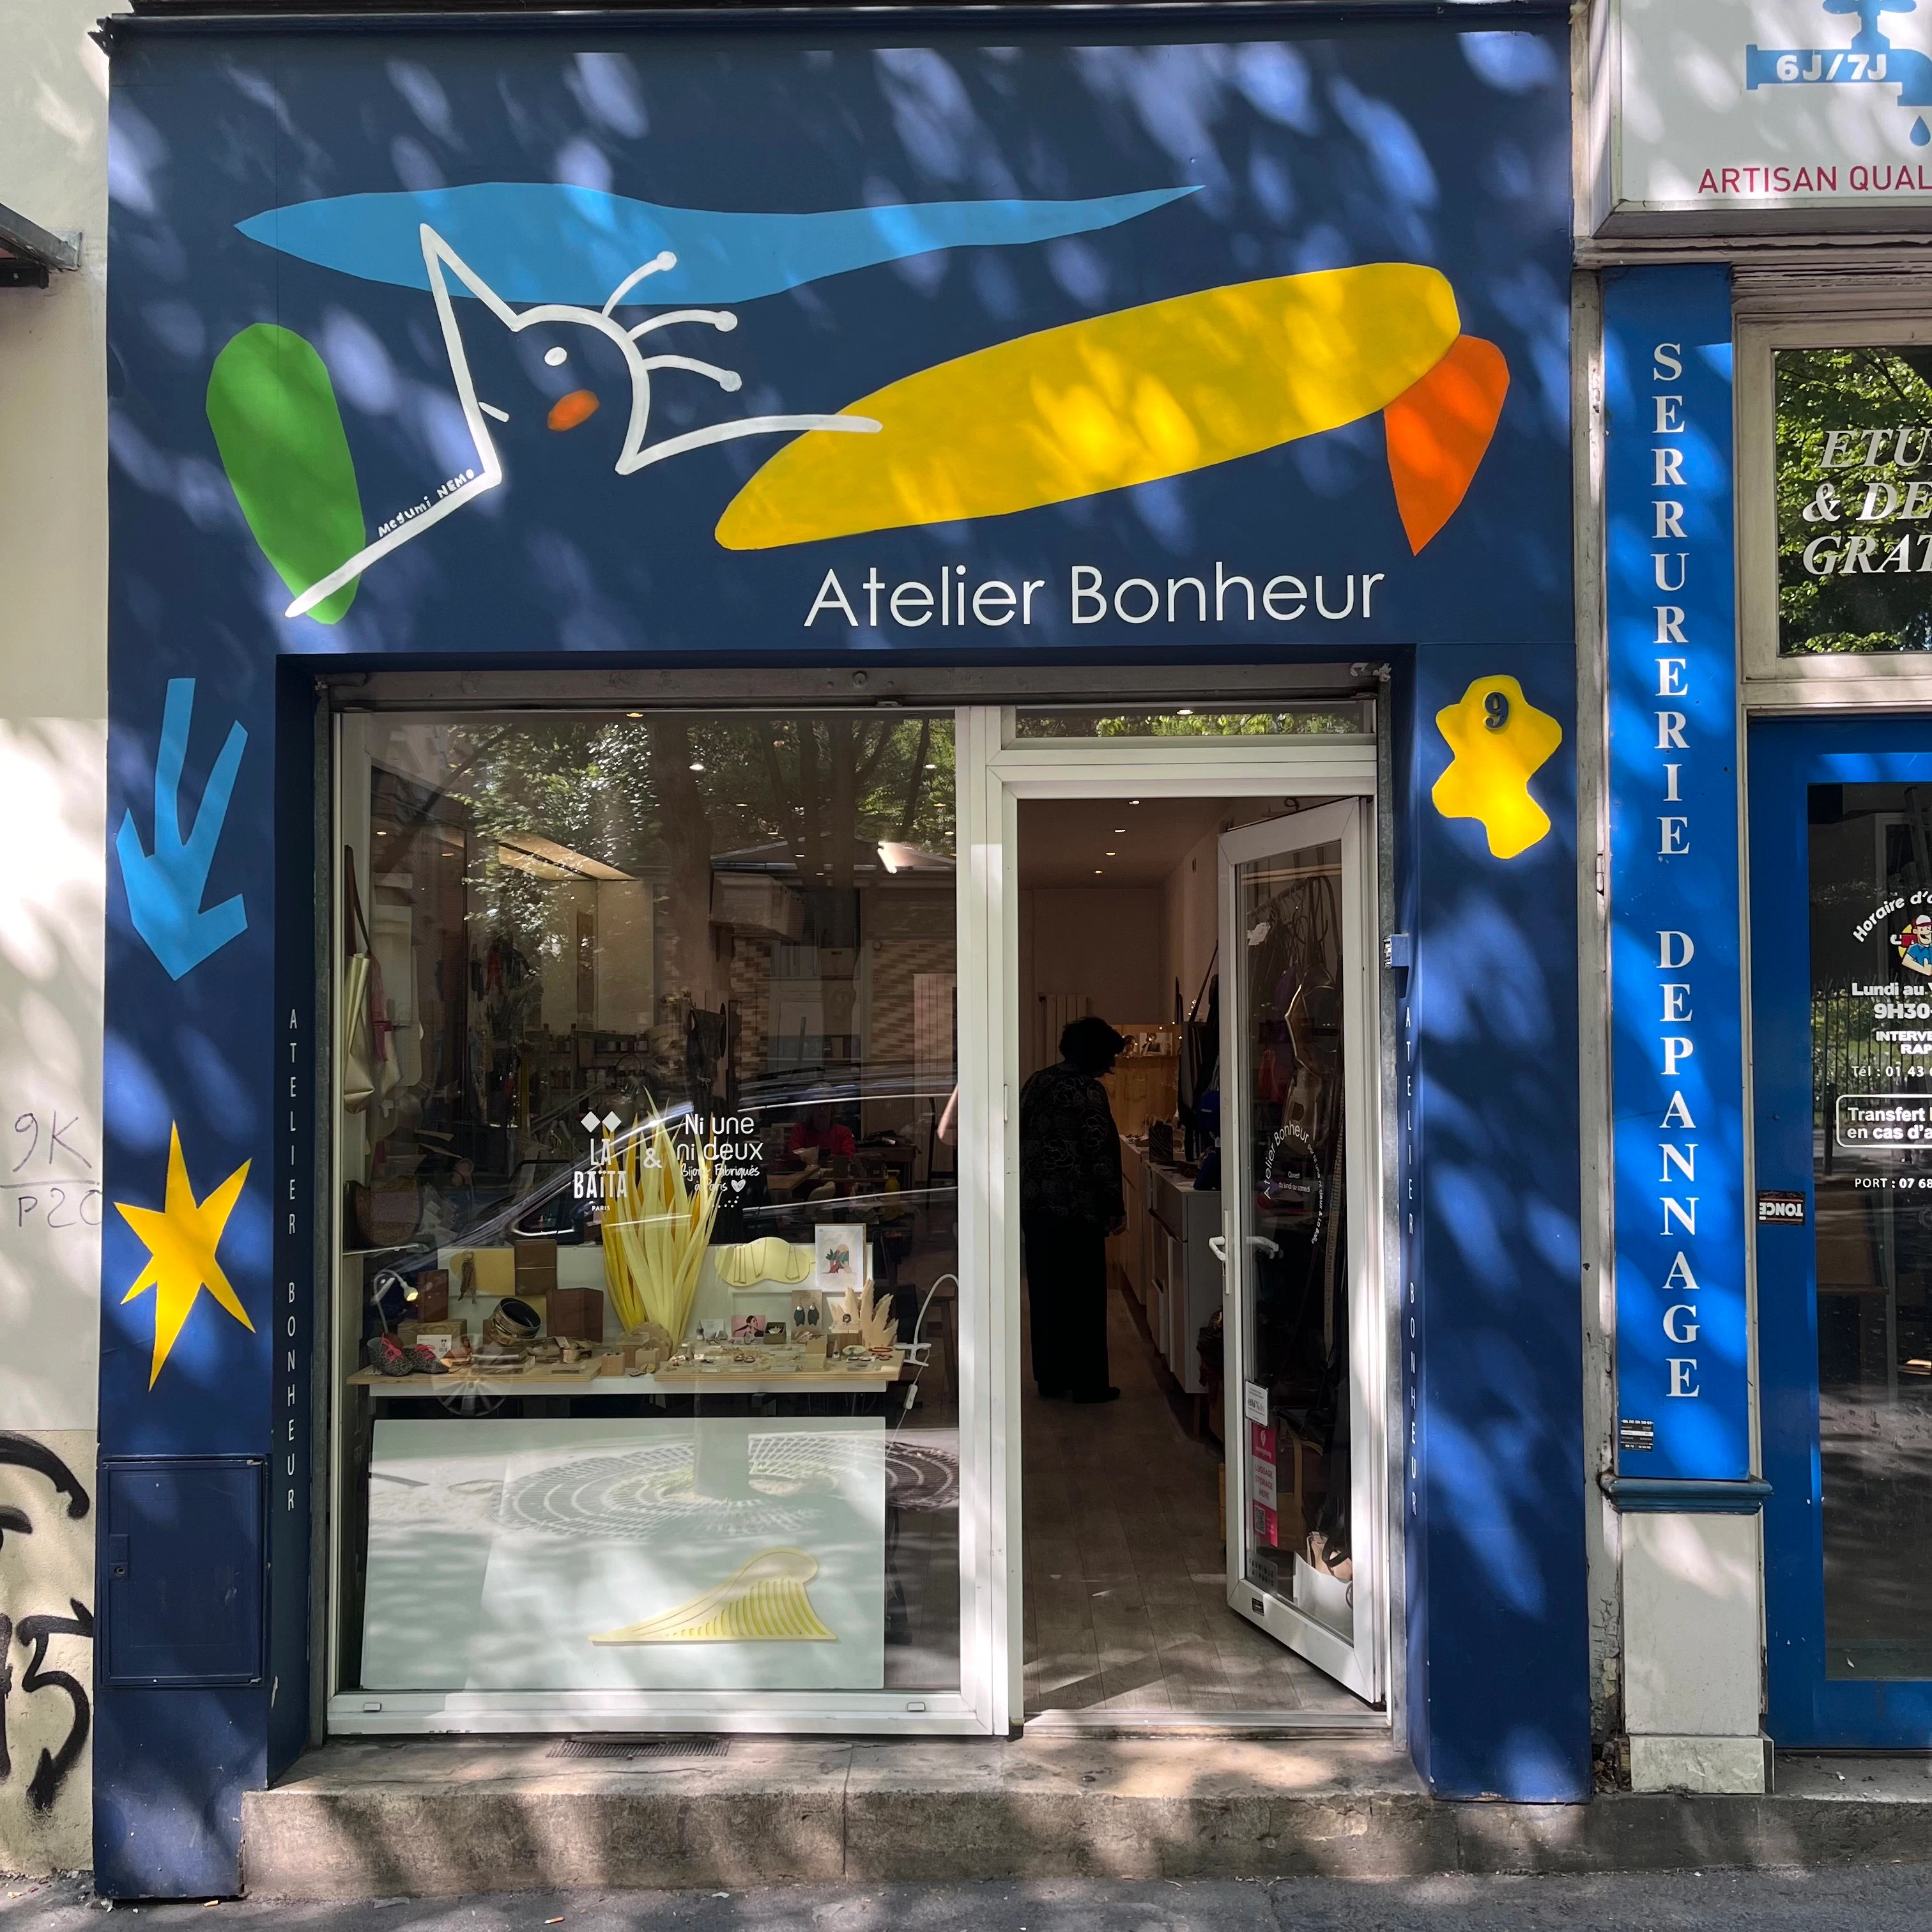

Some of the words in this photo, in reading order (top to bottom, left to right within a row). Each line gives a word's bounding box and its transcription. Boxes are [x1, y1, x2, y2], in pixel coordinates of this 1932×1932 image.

[1775, 54, 1887, 81] 6J/7J
[1698, 166, 1837, 194] ARTISAN
[1850, 164, 1932, 191] QUAL
[1817, 429, 1932, 468] ETU
[378, 495, 431, 537] Megumi
[1802, 482, 1841, 523] &
[804, 564, 1045, 628] Atelier
[1071, 561, 1385, 625] Bonheur
[1651, 342, 1690, 855] SERRURERIE
[1482, 691, 1510, 730] 9
[1853, 897, 1905, 942] Horaire
[1851, 982, 1899, 996] Lundi
[1903, 985, 1924, 996] au
[1851, 1065, 1871, 1077] Tél
[1885, 1066, 1901, 1077] 01
[1907, 1066, 1924, 1077] 43
[288, 1008, 298, 1235] ATELIER
[685, 1113, 704, 1135] Ni
[712, 1116, 755, 1135] une
[1406, 1007, 1414, 1235] ATELIER
[1847, 1107, 1926, 1122] Transfert
[1847, 1128, 1868, 1139] en
[1873, 1128, 1904, 1140] cas
[590, 1138, 611, 1166] LA
[643, 1147, 663, 1169] &
[677, 1142, 695, 1161] ni
[703, 1135, 764, 1162] deux
[1263, 1142, 1276, 1200] Atelier
[1274, 1120, 1310, 1147] Bonheur
[1656, 930, 1701, 1398] DEPANNAGE
[1855, 1178, 1888, 1188] PORT
[1899, 1179, 1914, 1188] 07
[1918, 1178, 1932, 1188] 68
[288, 1282, 296, 1512] BONHEUR
